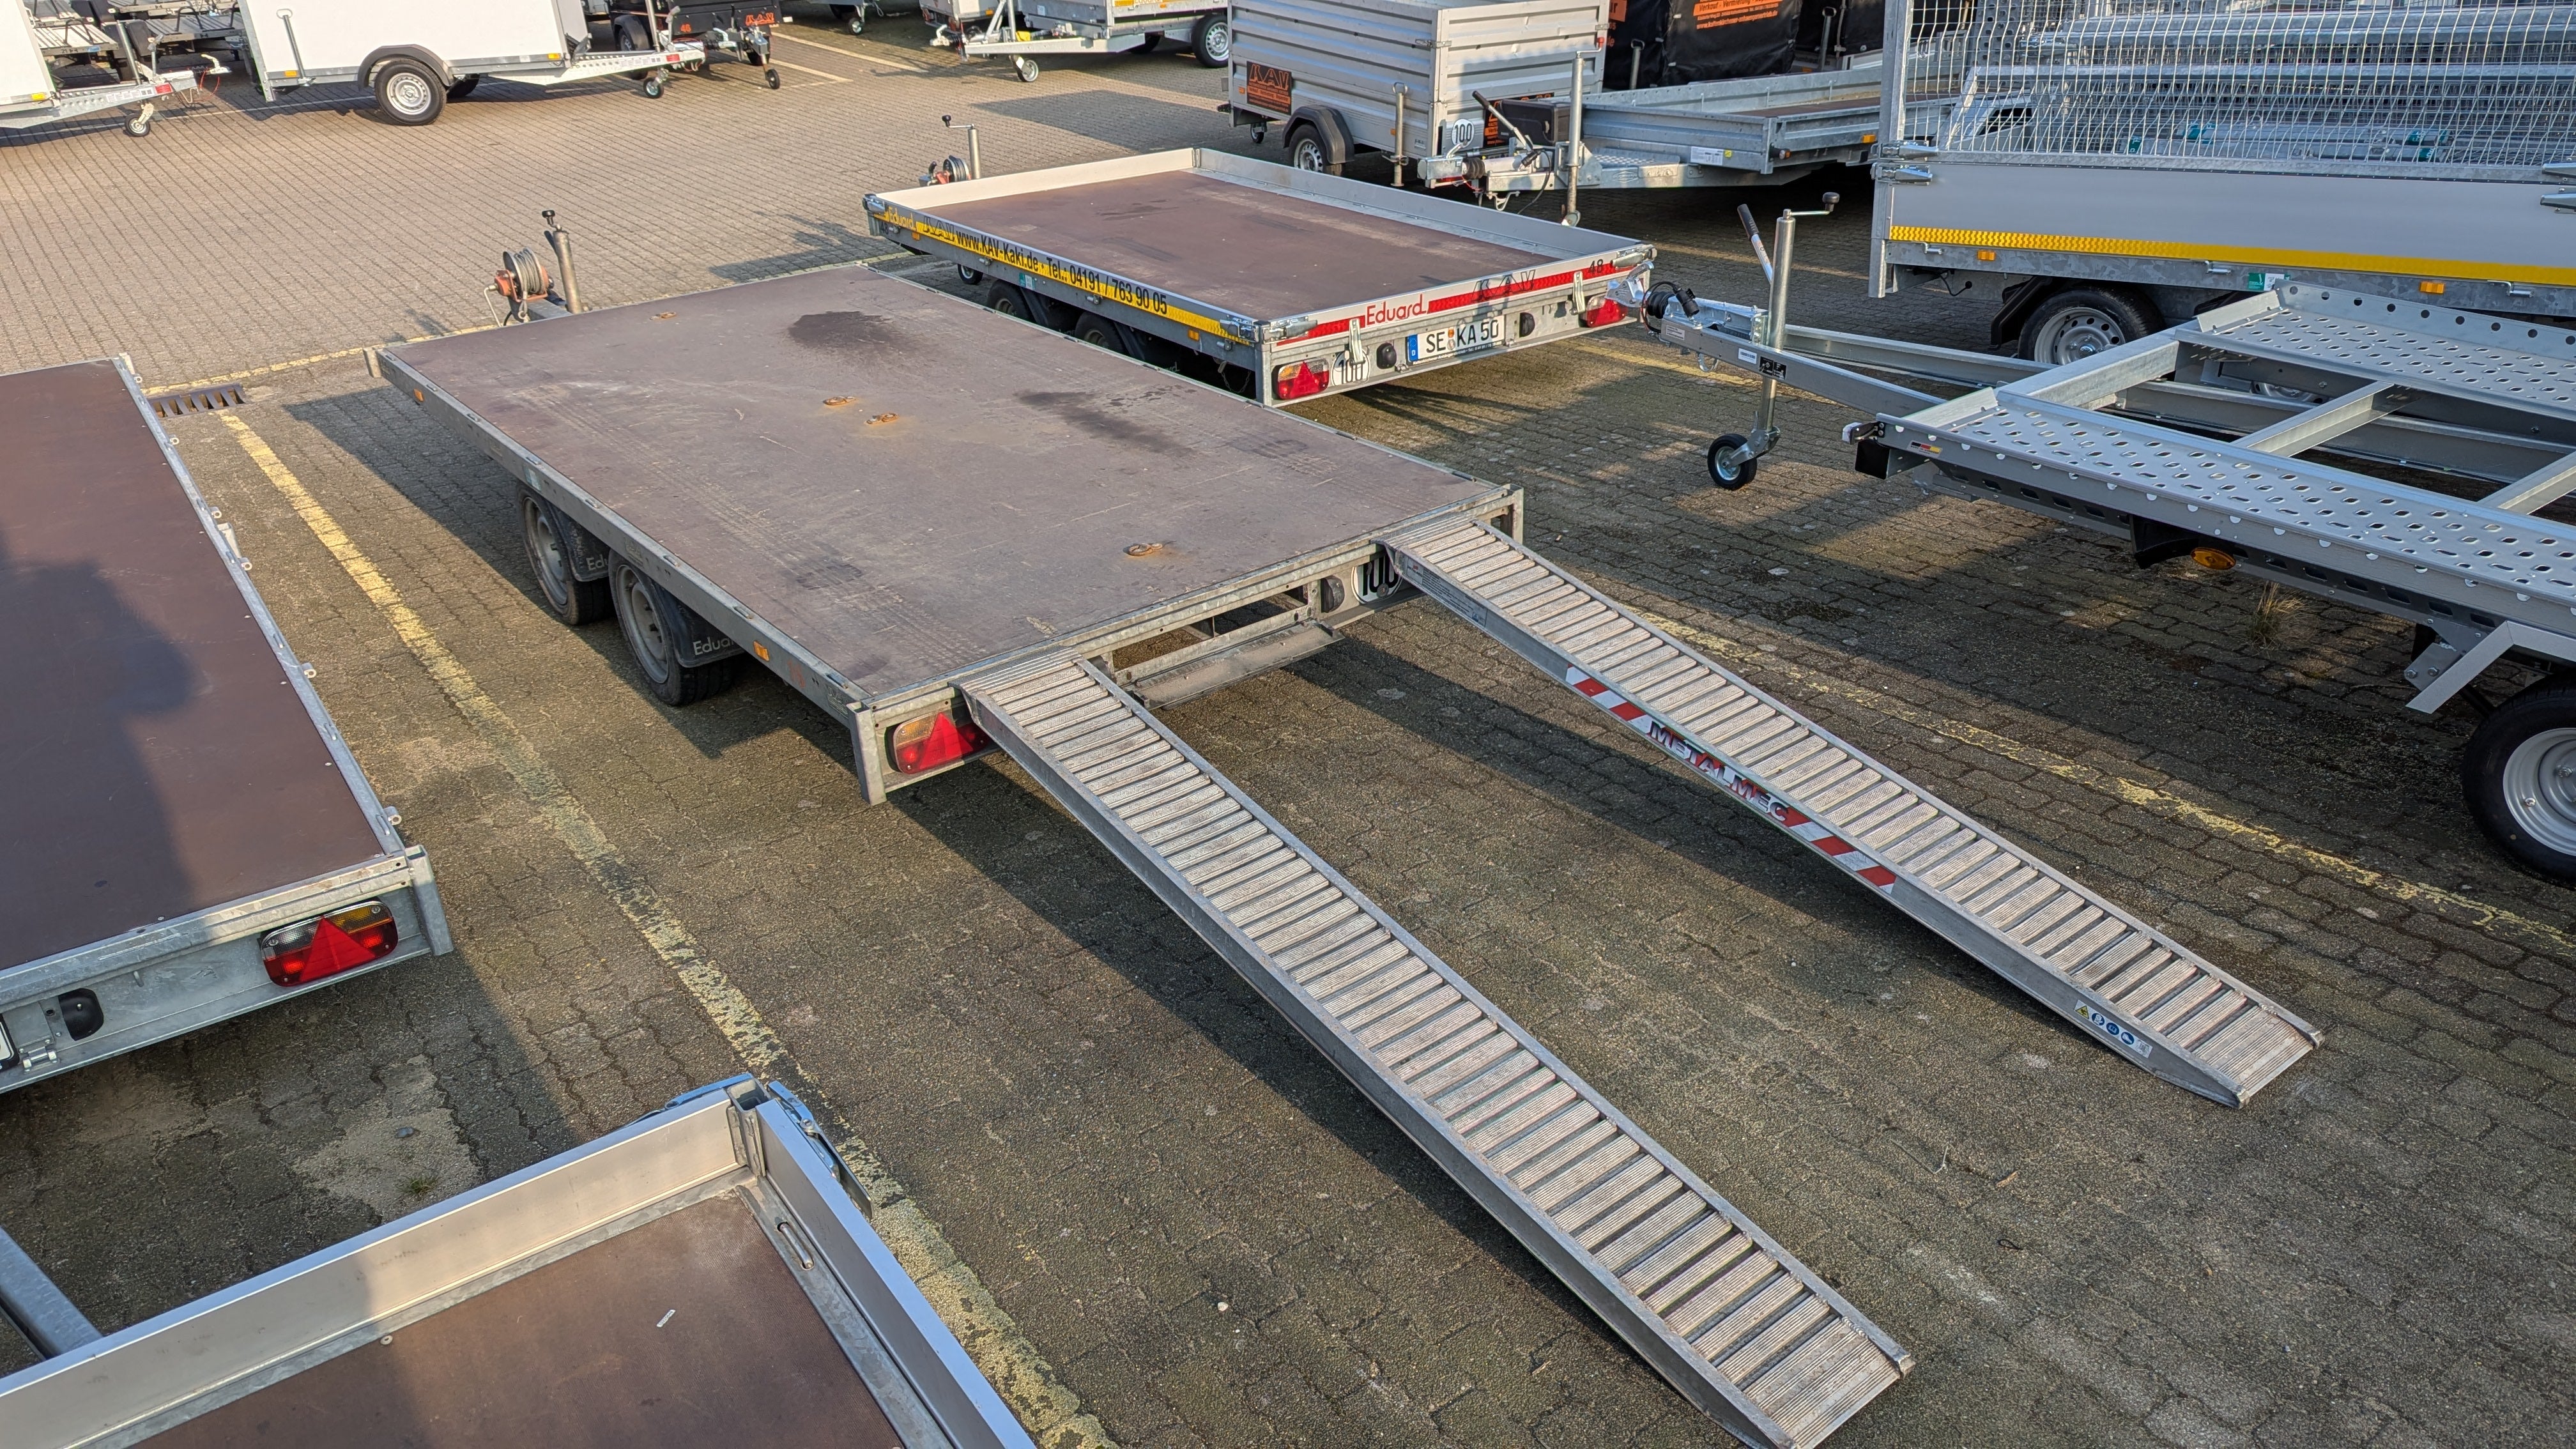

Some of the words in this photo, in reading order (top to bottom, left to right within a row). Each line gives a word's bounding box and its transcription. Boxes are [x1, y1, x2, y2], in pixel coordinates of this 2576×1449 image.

[1249, 63, 1289, 91] KAV
[1454, 123, 1473, 143] 100
[888, 206, 916, 231] Eduard
[956, 231, 1039, 272] www.KAV-Kaki.de
[1046, 257, 1068, 282] Tel.:
[1070, 264, 1100, 294] 04191
[1112, 278, 1133, 303] 763
[1136, 286, 1151, 309] 90
[1153, 291, 1168, 315] 05
[1367, 293, 1427, 326] Eduard
[1471, 269, 1536, 302] KAV
[1588, 259, 1604, 274] 48
[1426, 331, 1446, 353] SE
[1457, 325, 1477, 348] KA
[1480, 319, 1499, 341] 50
[1648, 720, 1790, 822] METALMEC
